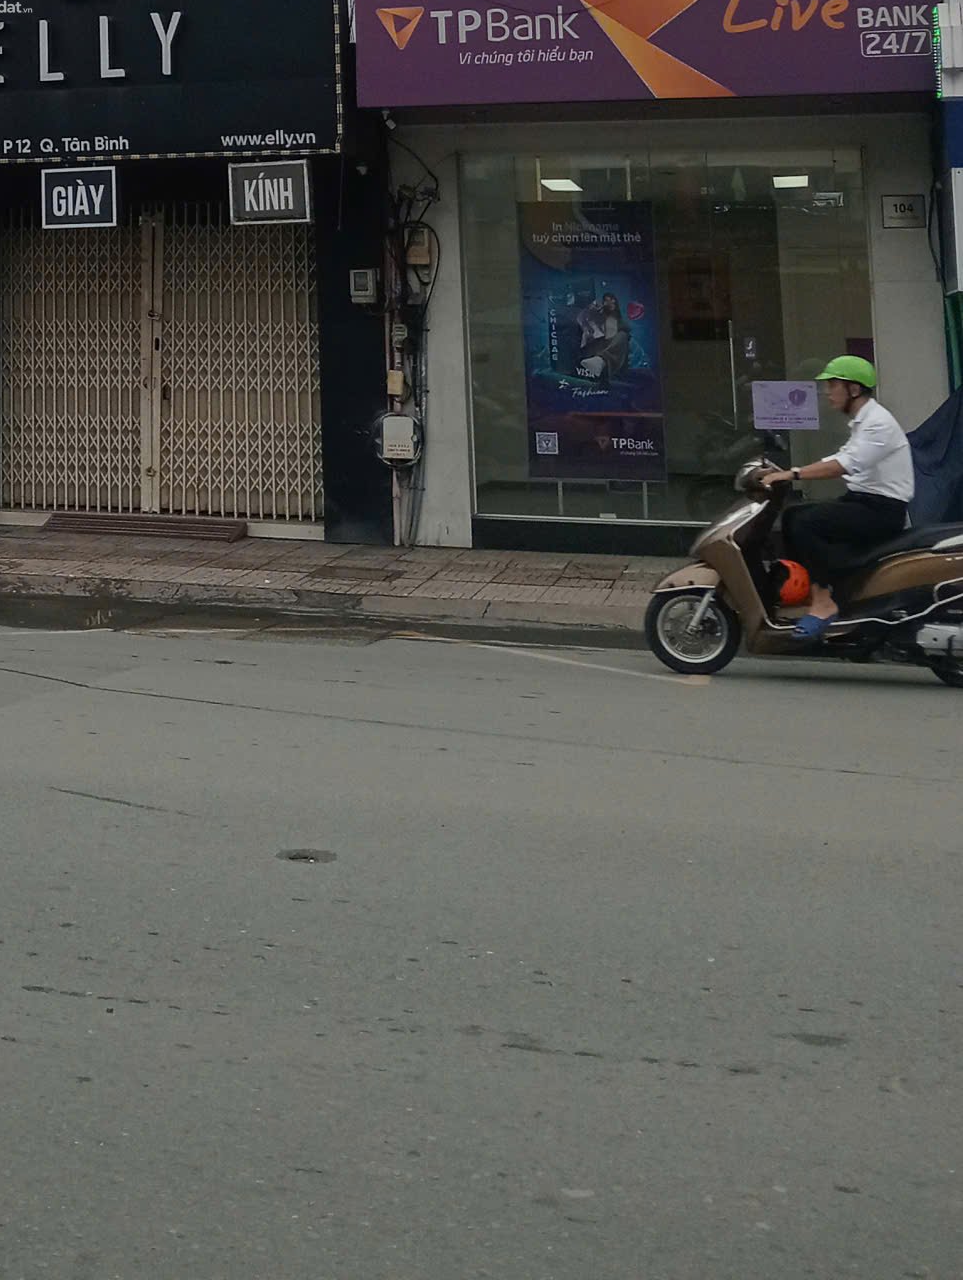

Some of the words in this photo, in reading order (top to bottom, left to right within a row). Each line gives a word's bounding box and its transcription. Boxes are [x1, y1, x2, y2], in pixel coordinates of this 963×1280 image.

[429, 5, 580, 45] TPBank
[856, 4, 930, 28] BANK
[864, 31, 927, 55] 24/7
[459, 51, 472, 65] Vì
[474, 49, 514, 67] chúng
[517, 48, 534, 63] tôi
[537, 45, 566, 62] hiểu
[569, 48, 594, 63] bạn
[40, 137, 59, 153] Q.
[61, 137, 90, 153] Tân
[94, 135, 129, 151] Bình
[220, 130, 317, 148] www.elly.vn
[51, 179, 105, 218] GIÀY
[242, 172, 295, 213] KÍNH
[892, 203, 914, 213] 104
[611, 437, 654, 450] TPBank
